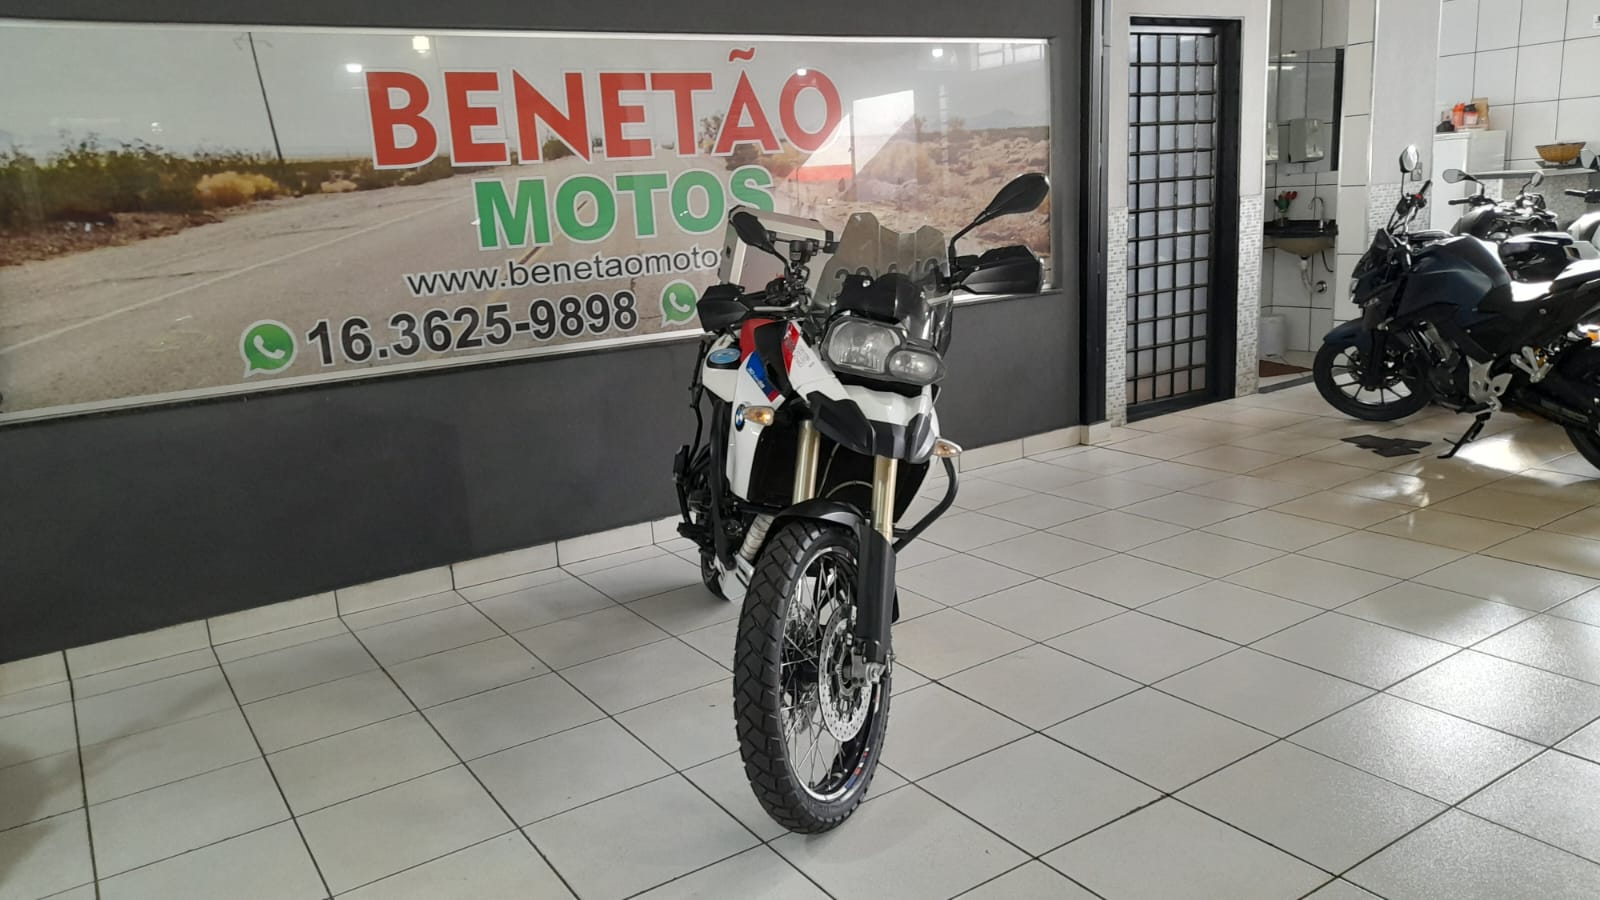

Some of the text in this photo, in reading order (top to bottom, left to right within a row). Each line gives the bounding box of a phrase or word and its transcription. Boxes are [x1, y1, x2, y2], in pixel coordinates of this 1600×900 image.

[365, 47, 842, 167] BENETÃO
[473, 167, 775, 248] MOTOS
[407, 246, 722, 295] www.benetaomoto
[307, 291, 637, 366] 16.3625-9898
